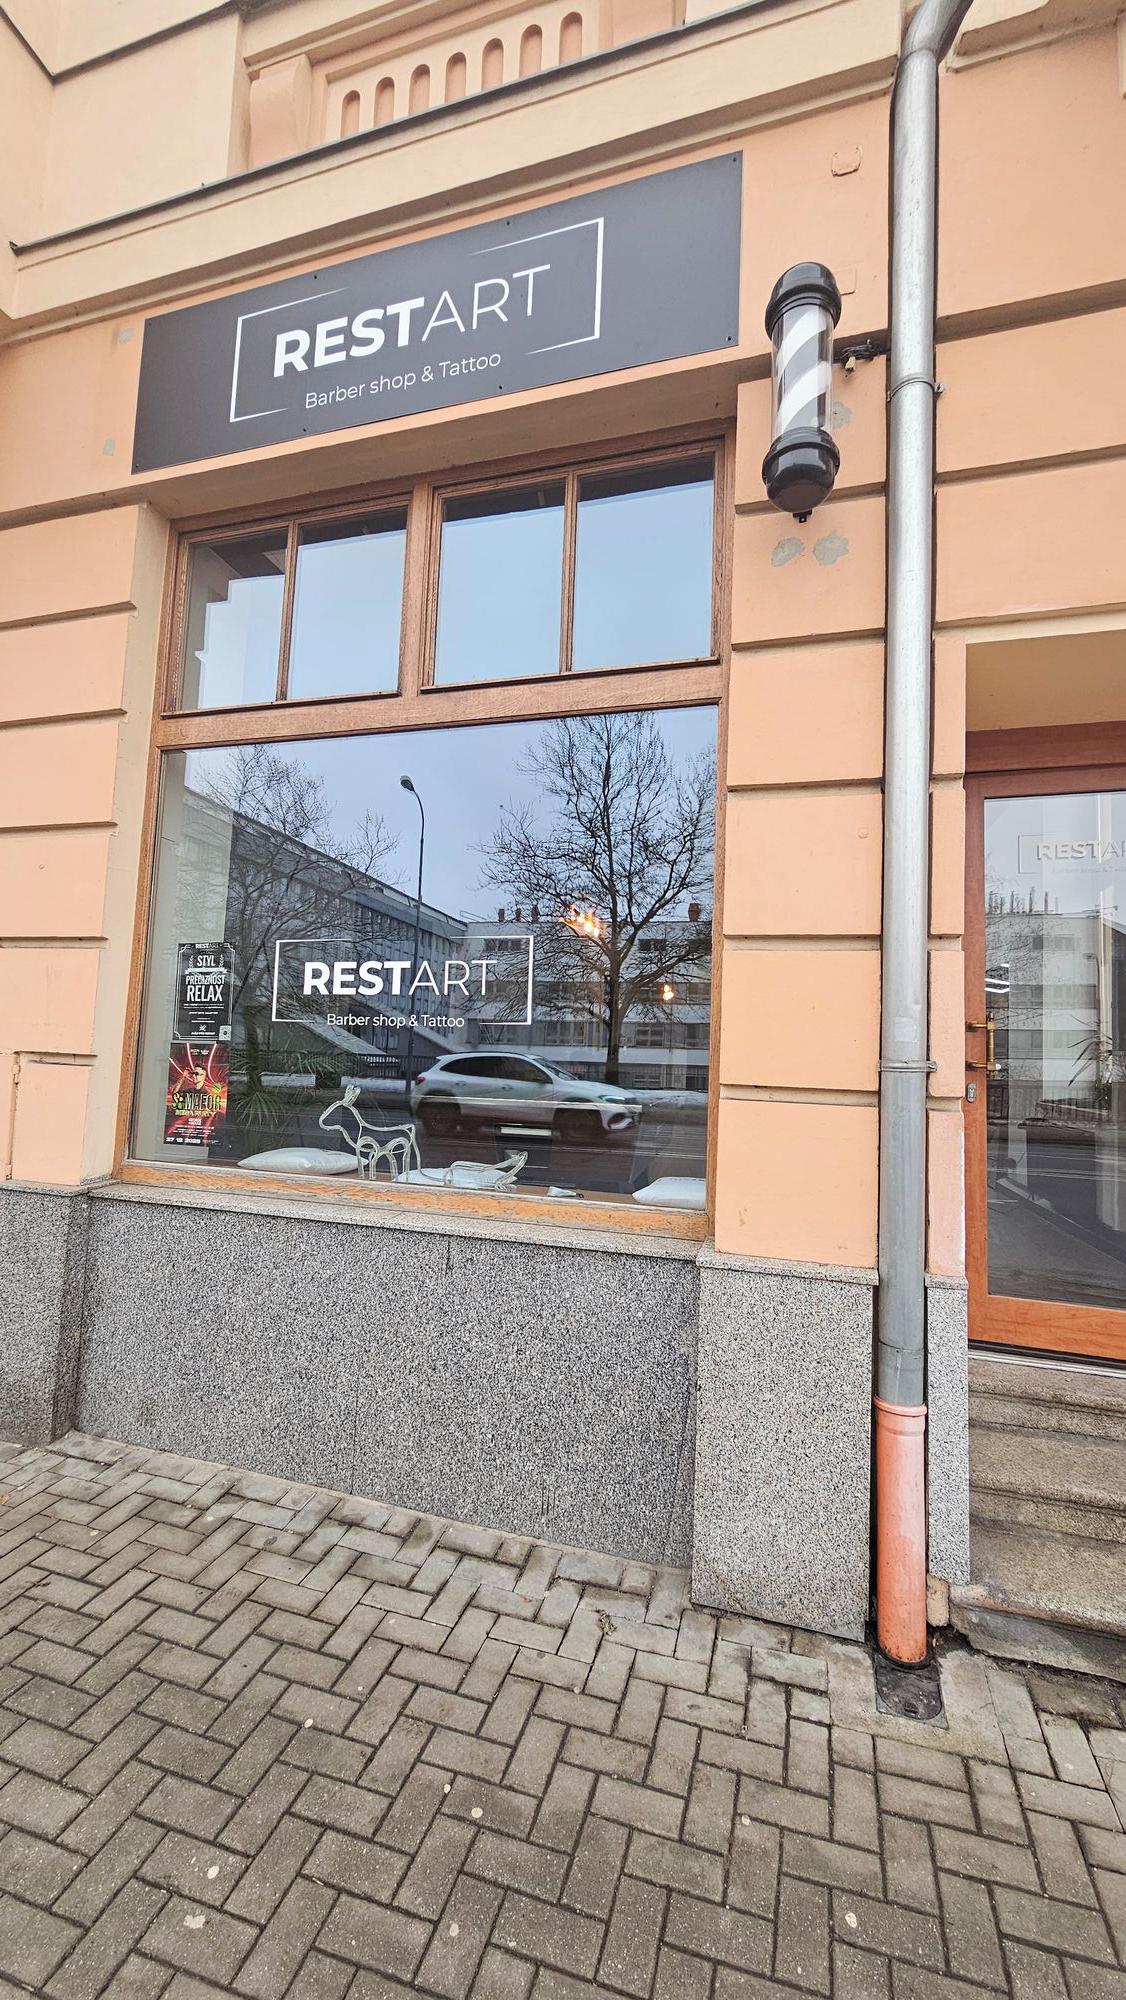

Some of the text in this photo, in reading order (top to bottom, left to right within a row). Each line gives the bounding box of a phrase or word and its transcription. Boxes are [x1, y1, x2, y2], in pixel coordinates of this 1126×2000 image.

[273, 263, 551, 378] RESTART
[305, 353, 502, 409] Barber shop & Tattoo
[196, 955, 216, 967] STYL
[303, 960, 498, 996] RESTART
[187, 985, 224, 1002] RELAX
[327, 1013, 465, 1029] Barber shop & Tattoo
